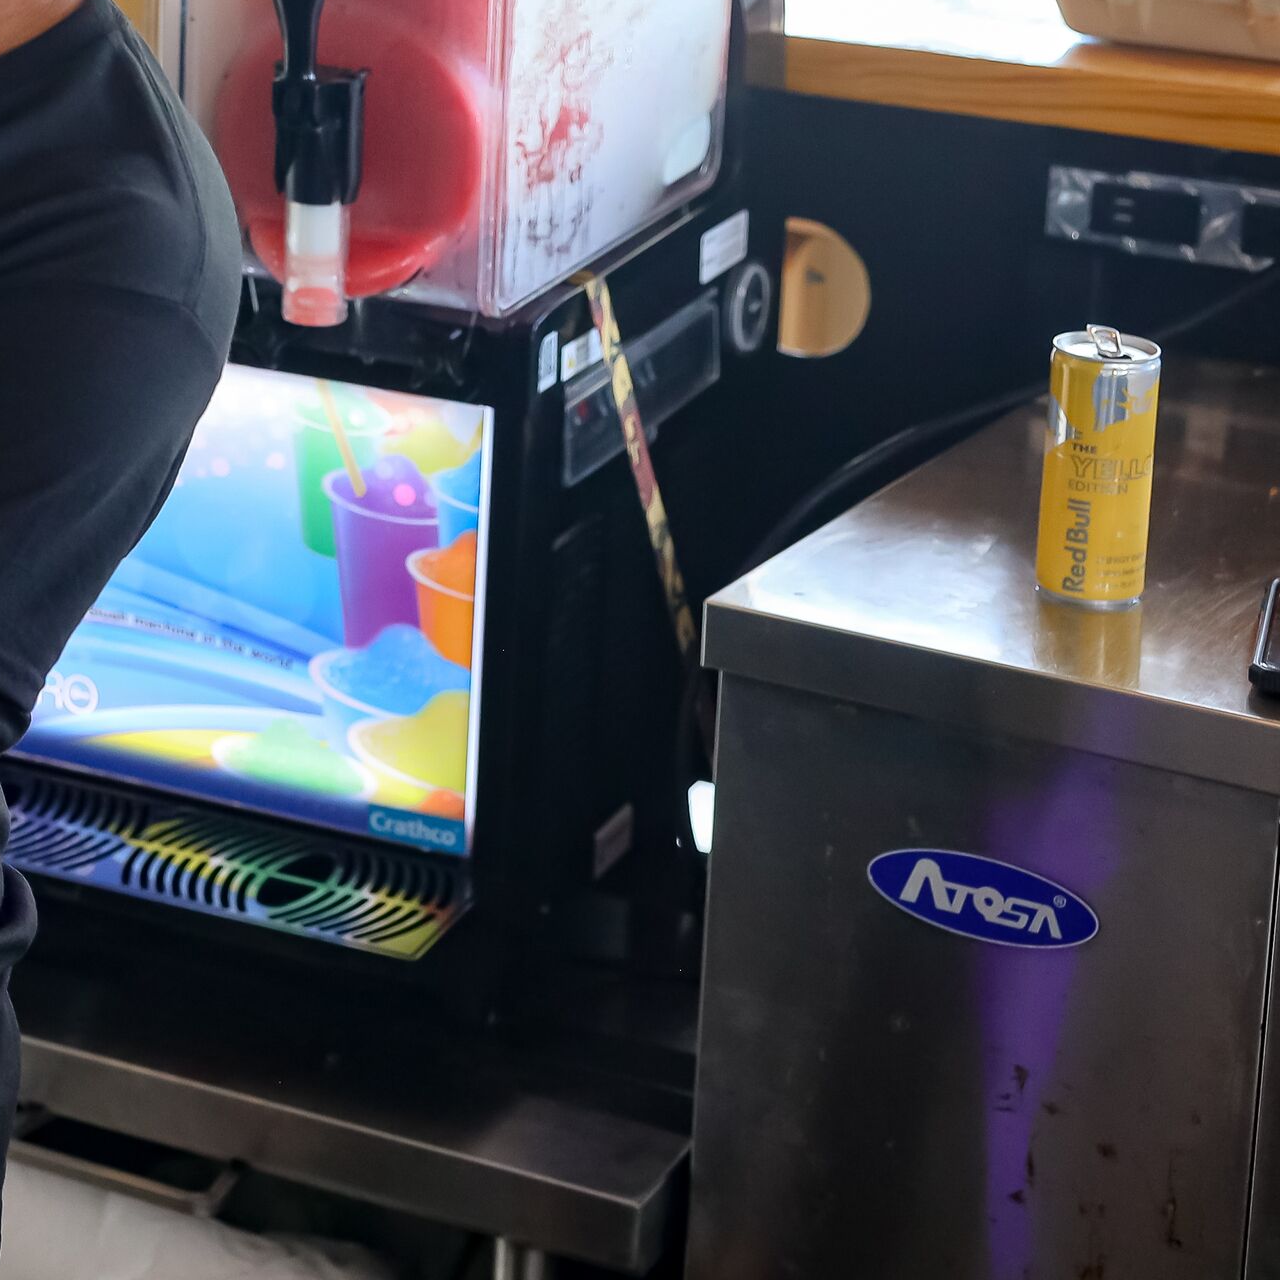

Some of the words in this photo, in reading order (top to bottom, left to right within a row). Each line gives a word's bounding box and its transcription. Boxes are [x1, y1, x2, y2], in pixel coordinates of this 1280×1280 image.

[1072, 442, 1097, 453] THE
[1068, 480, 1128, 494] EDITION
[1066, 498, 1091, 545] Bull
[1062, 546, 1087, 593] Red
[369, 810, 457, 847] Crathco
[899, 858, 1063, 940] ATOSA
